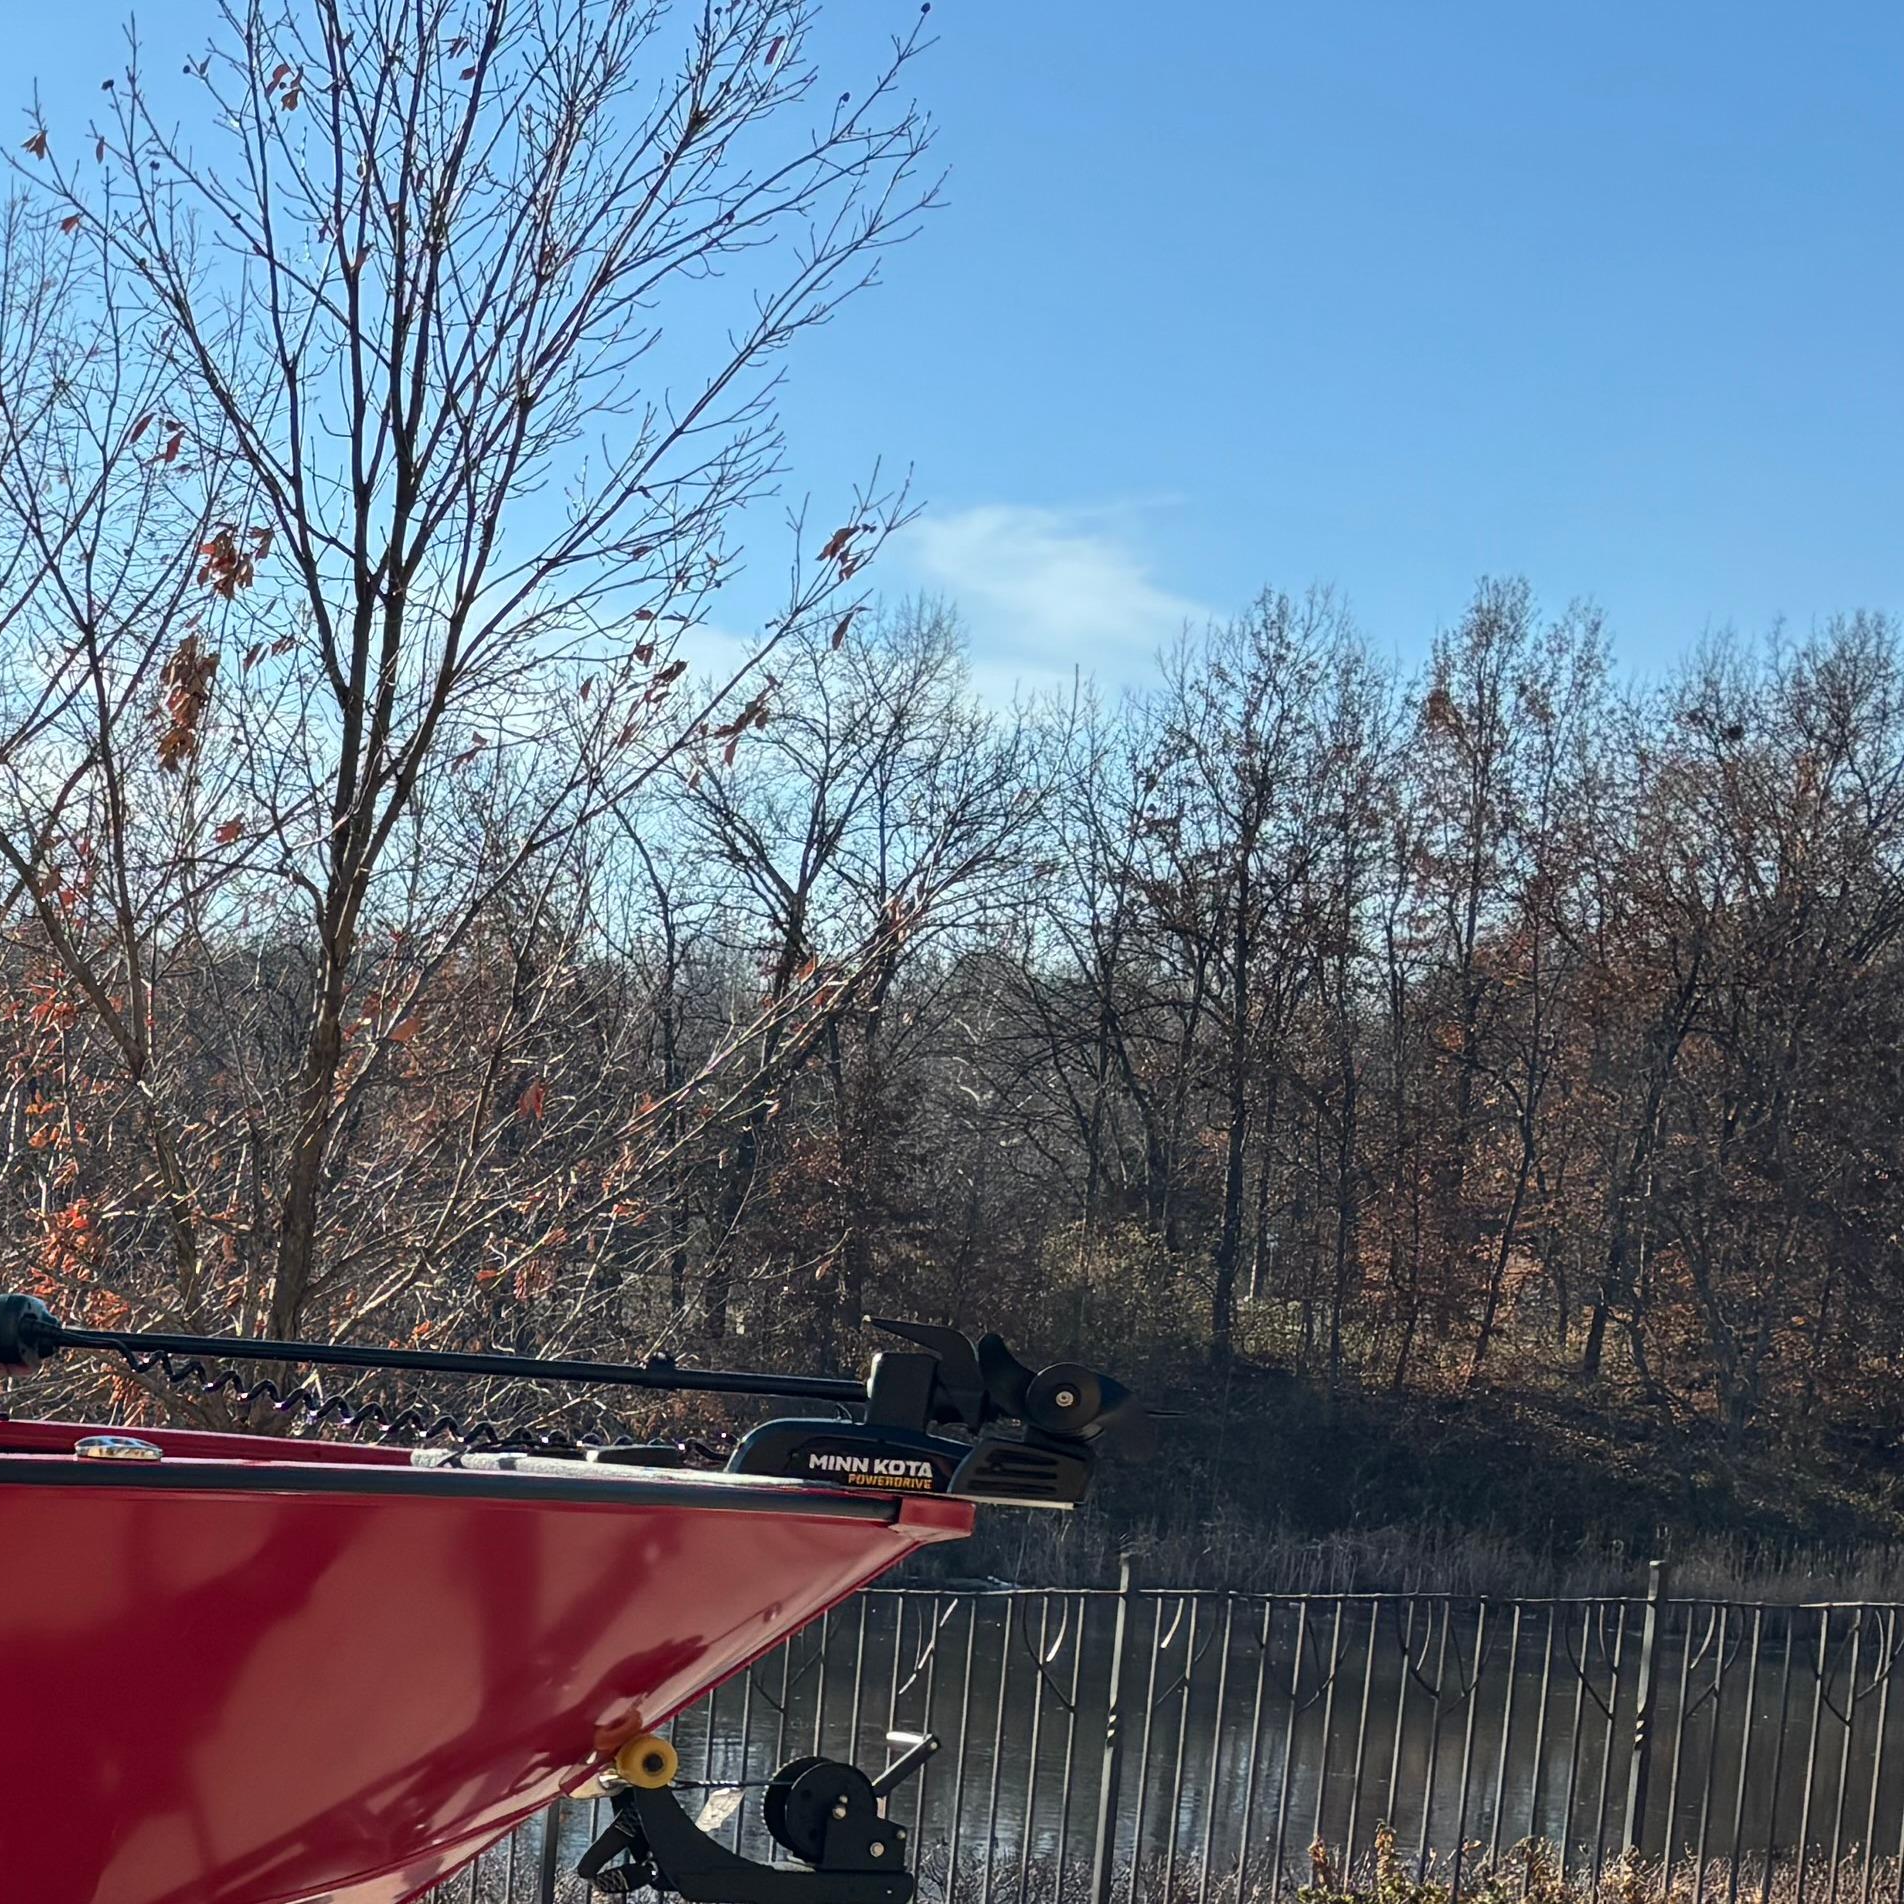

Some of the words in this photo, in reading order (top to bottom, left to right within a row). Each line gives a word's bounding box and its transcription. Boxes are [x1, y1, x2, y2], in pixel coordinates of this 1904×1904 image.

[808, 1453, 869, 1474] MINN
[872, 1458, 933, 1478] KOTA
[847, 1472, 933, 1490] POWERDRIVE
